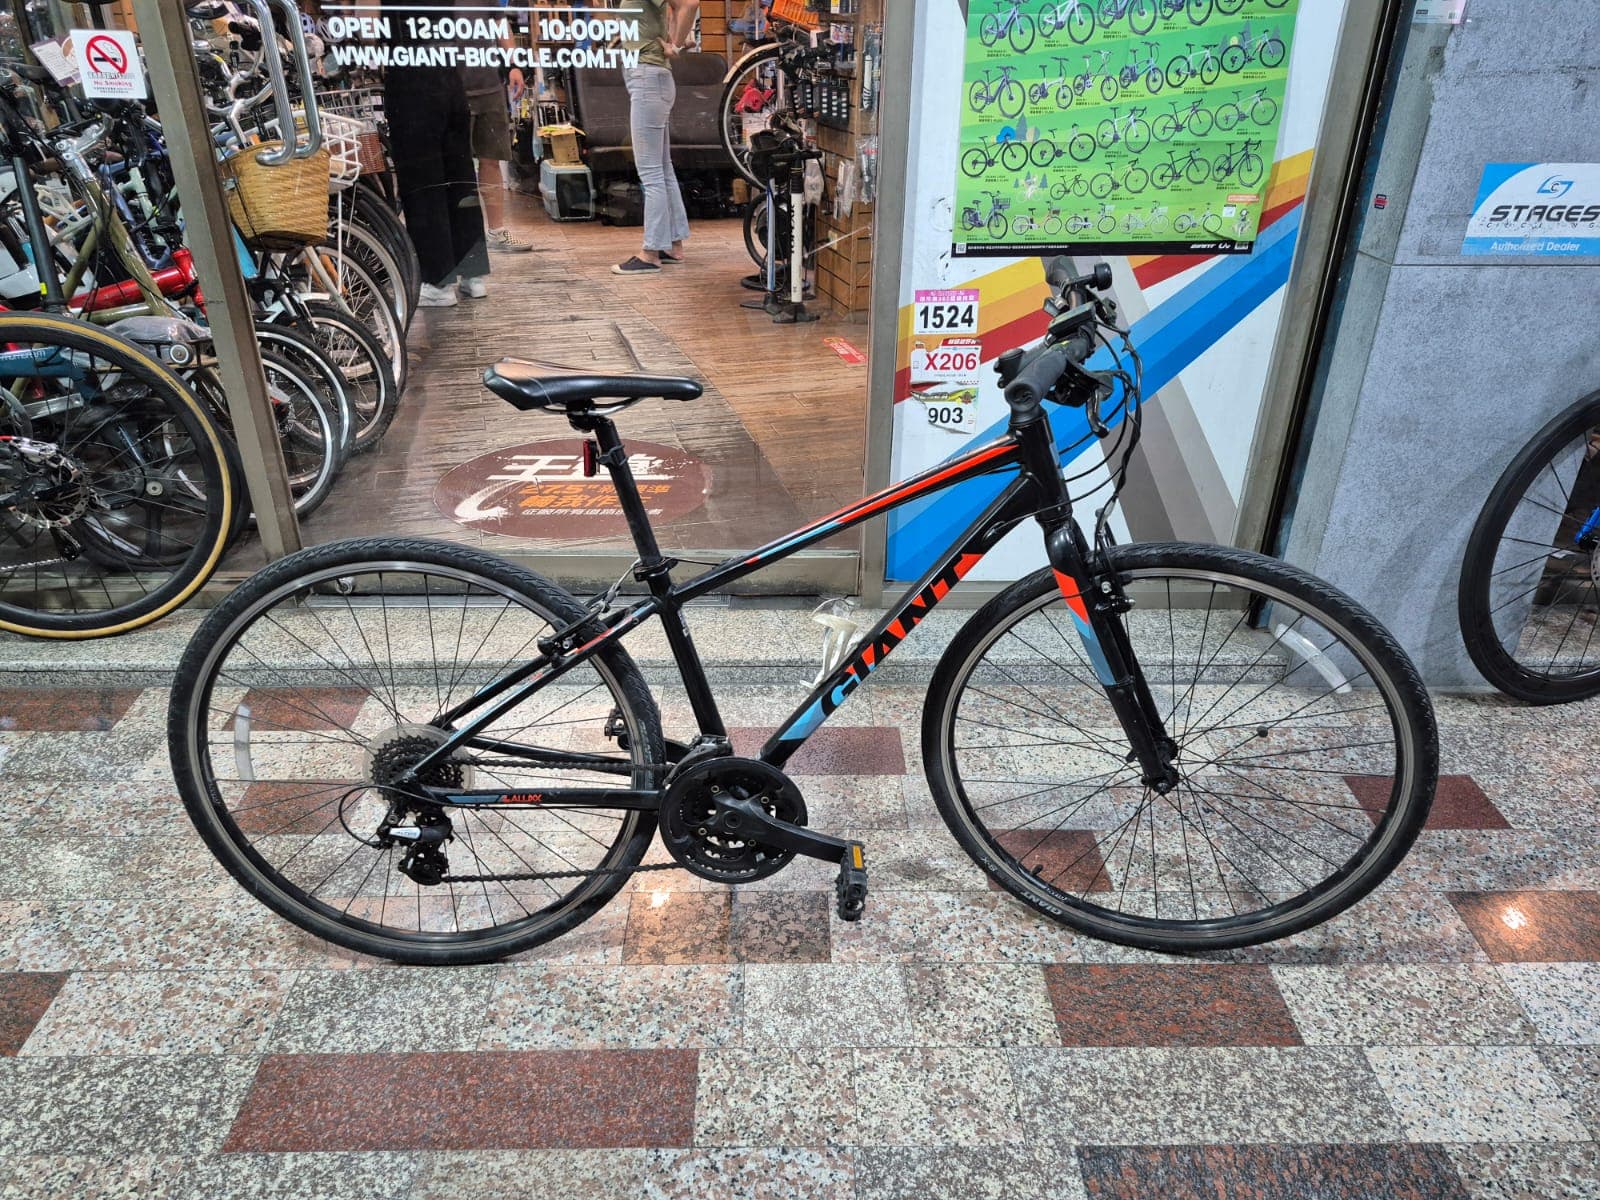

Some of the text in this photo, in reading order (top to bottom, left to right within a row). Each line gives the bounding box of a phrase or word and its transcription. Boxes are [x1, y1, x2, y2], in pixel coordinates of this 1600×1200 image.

[329, 16, 392, 39] OPEN
[539, 19, 640, 42] 10:00PM
[331, 45, 641, 69] WWW.GIANT-BICYCLE.COM.TW
[1489, 204, 1600, 222] STAGES
[1546, 241, 1581, 252] Dealer
[919, 304, 975, 329] 1524
[924, 352, 977, 371] X206
[928, 407, 964, 424] 903
[822, 549, 985, 718] GIANT
